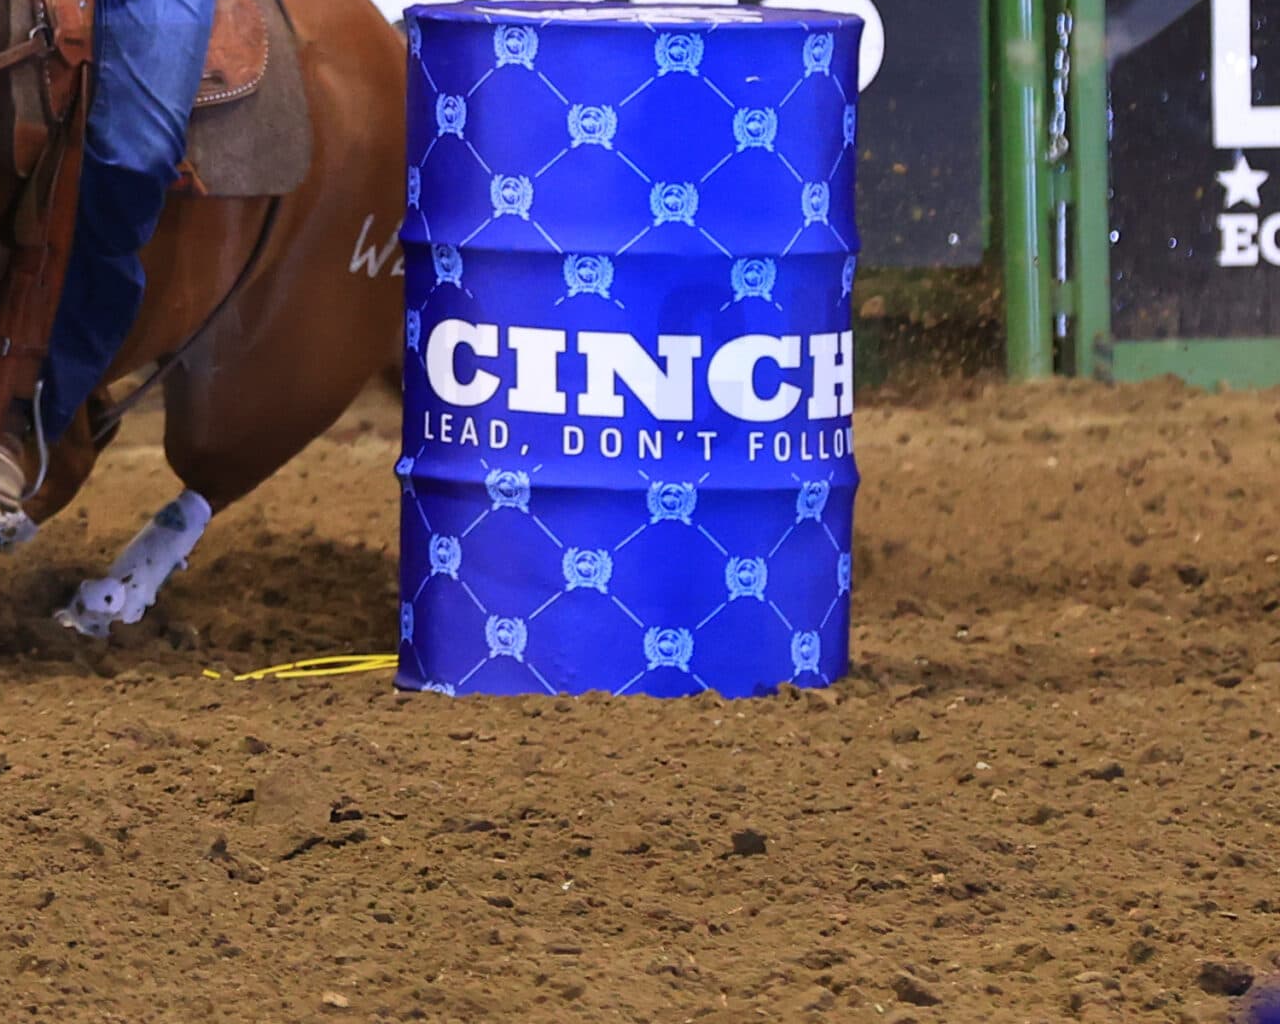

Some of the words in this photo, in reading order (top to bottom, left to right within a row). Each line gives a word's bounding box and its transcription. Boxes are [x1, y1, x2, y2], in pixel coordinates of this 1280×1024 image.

[425, 318, 854, 422] CINCH
[424, 411, 531, 456] LEAD,
[562, 424, 718, 461] DON'T
